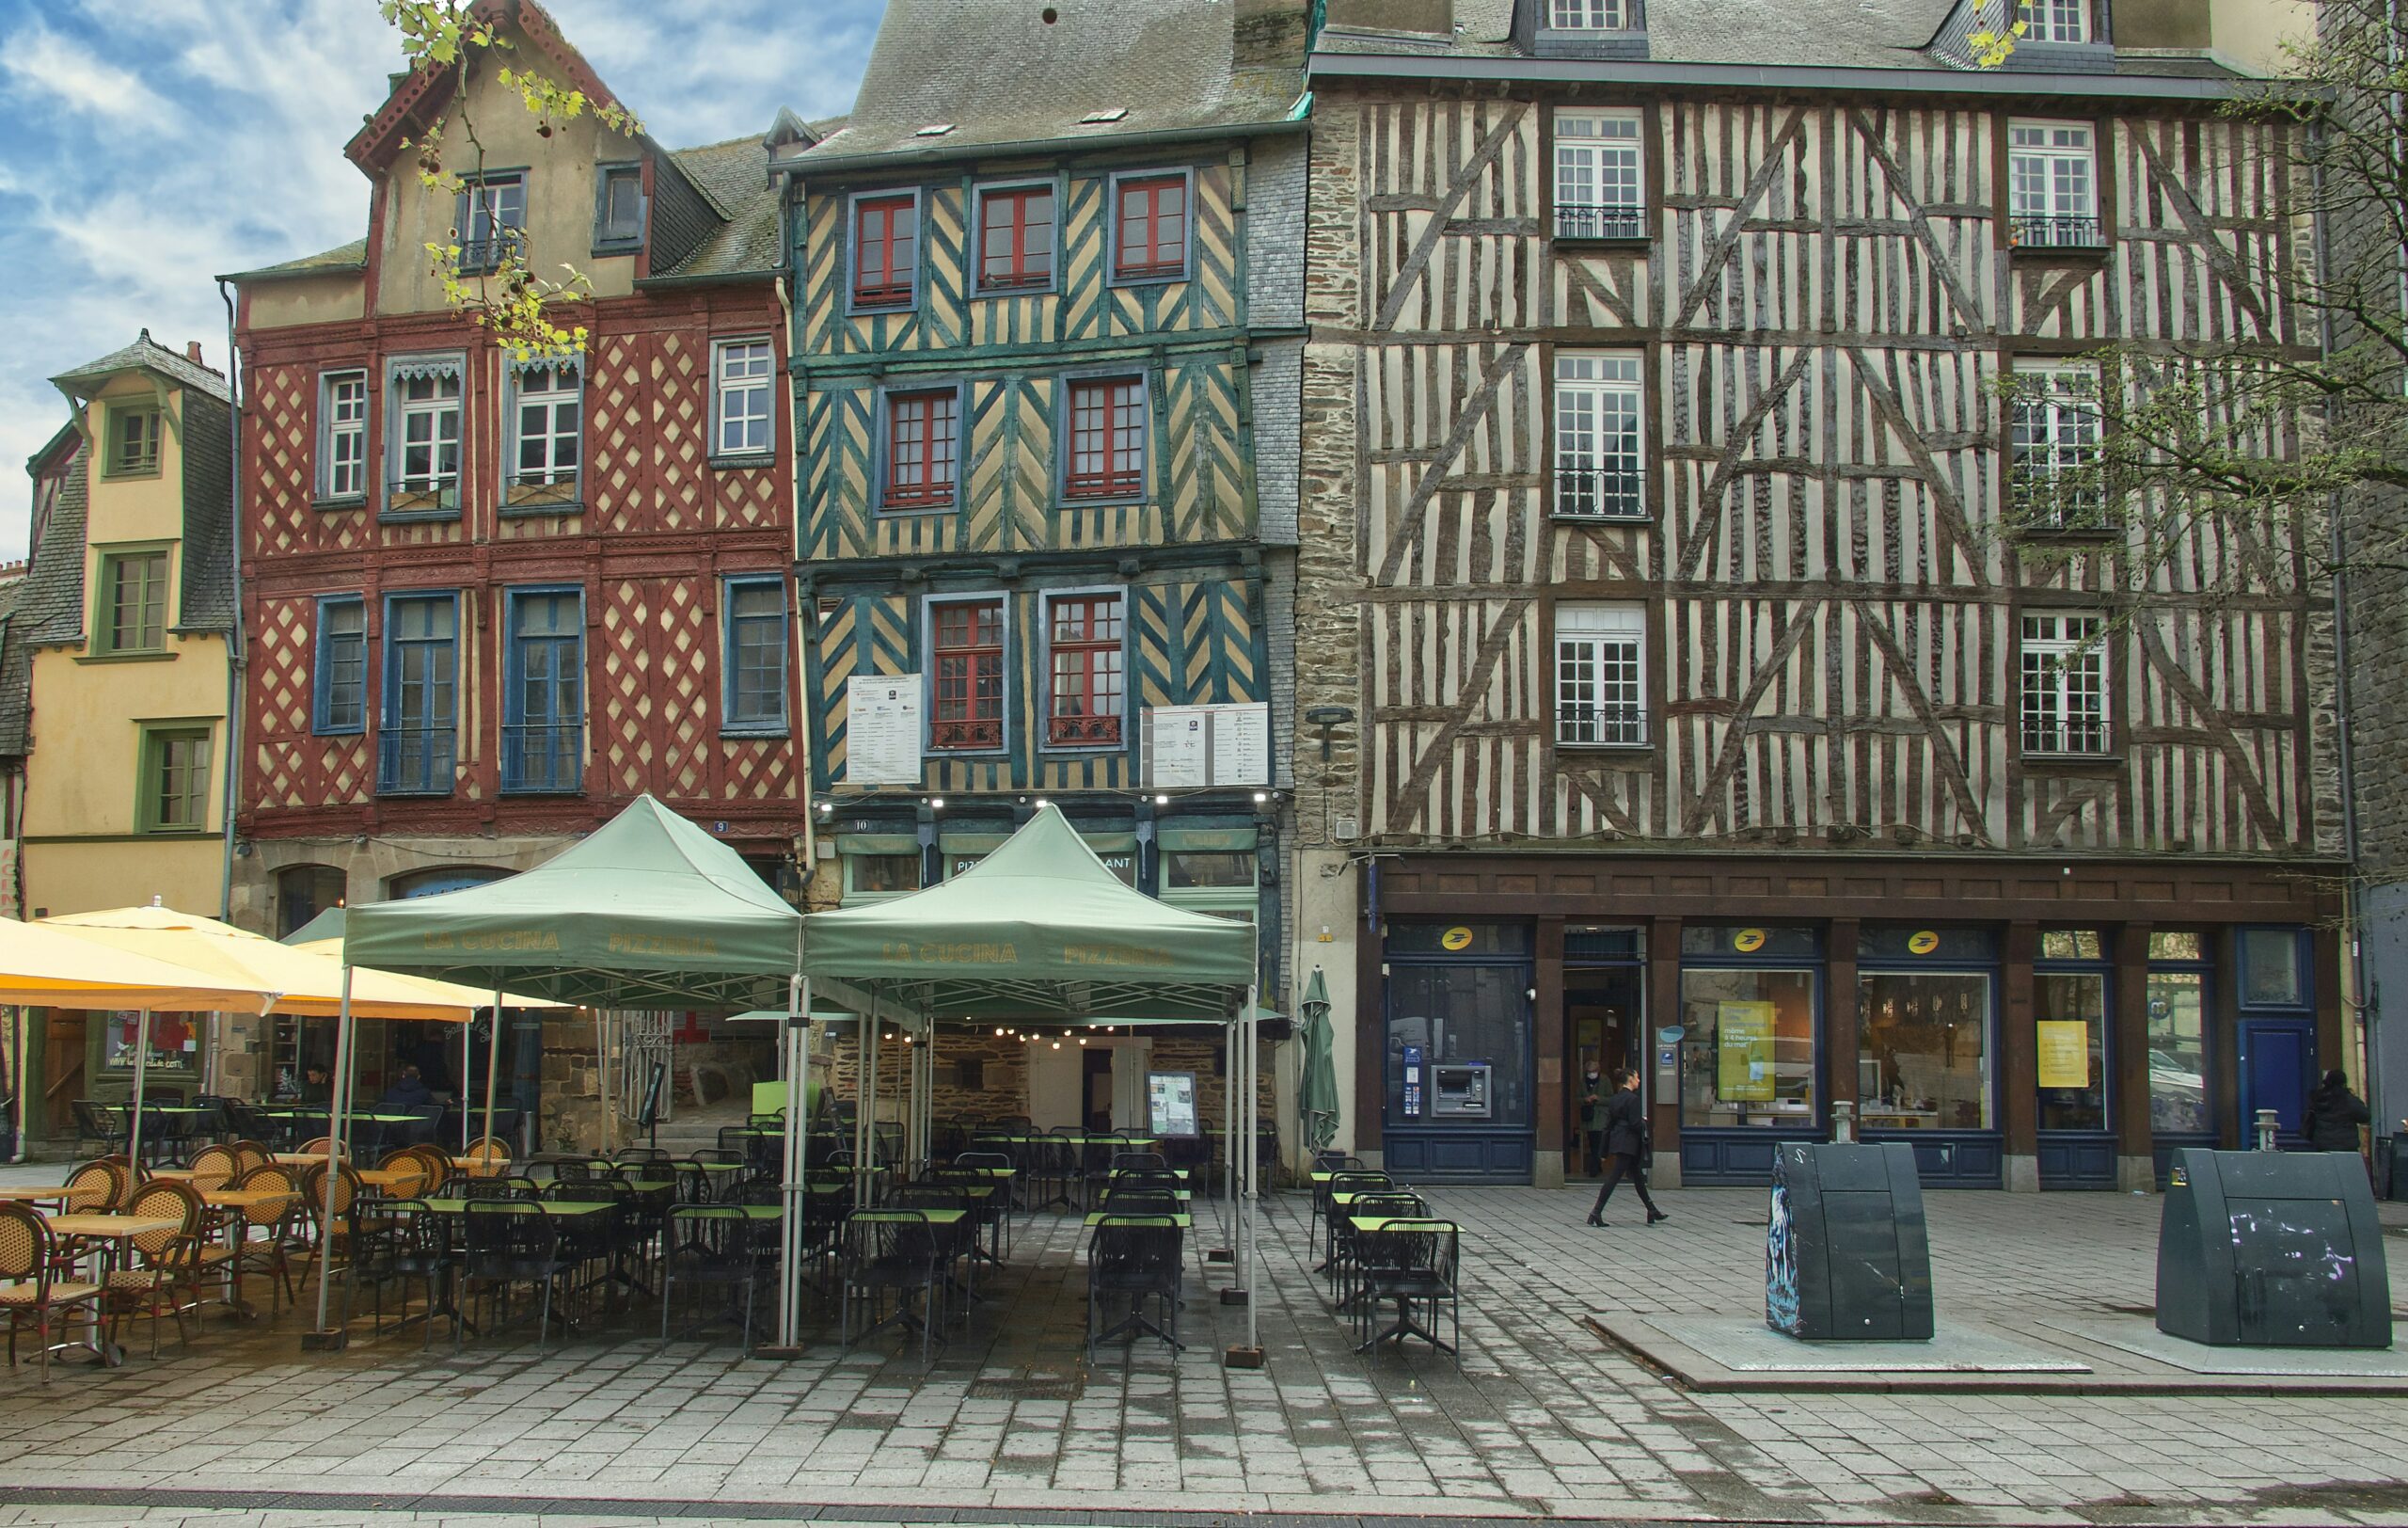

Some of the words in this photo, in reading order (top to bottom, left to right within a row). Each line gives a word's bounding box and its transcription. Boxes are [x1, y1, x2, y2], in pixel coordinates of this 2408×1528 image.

[718, 822, 723, 831] 9
[857, 821, 866, 830] 10
[958, 861, 981, 871] PIZ
[1104, 857, 1131, 868] ANT
[423, 931, 454, 950] LA
[461, 931, 560, 950] CUCINA
[609, 932, 718, 957] PIZZERIA
[882, 943, 911, 962] LA
[919, 943, 1019, 963] CUCINA
[1064, 945, 1175, 967] PIZZERIA
